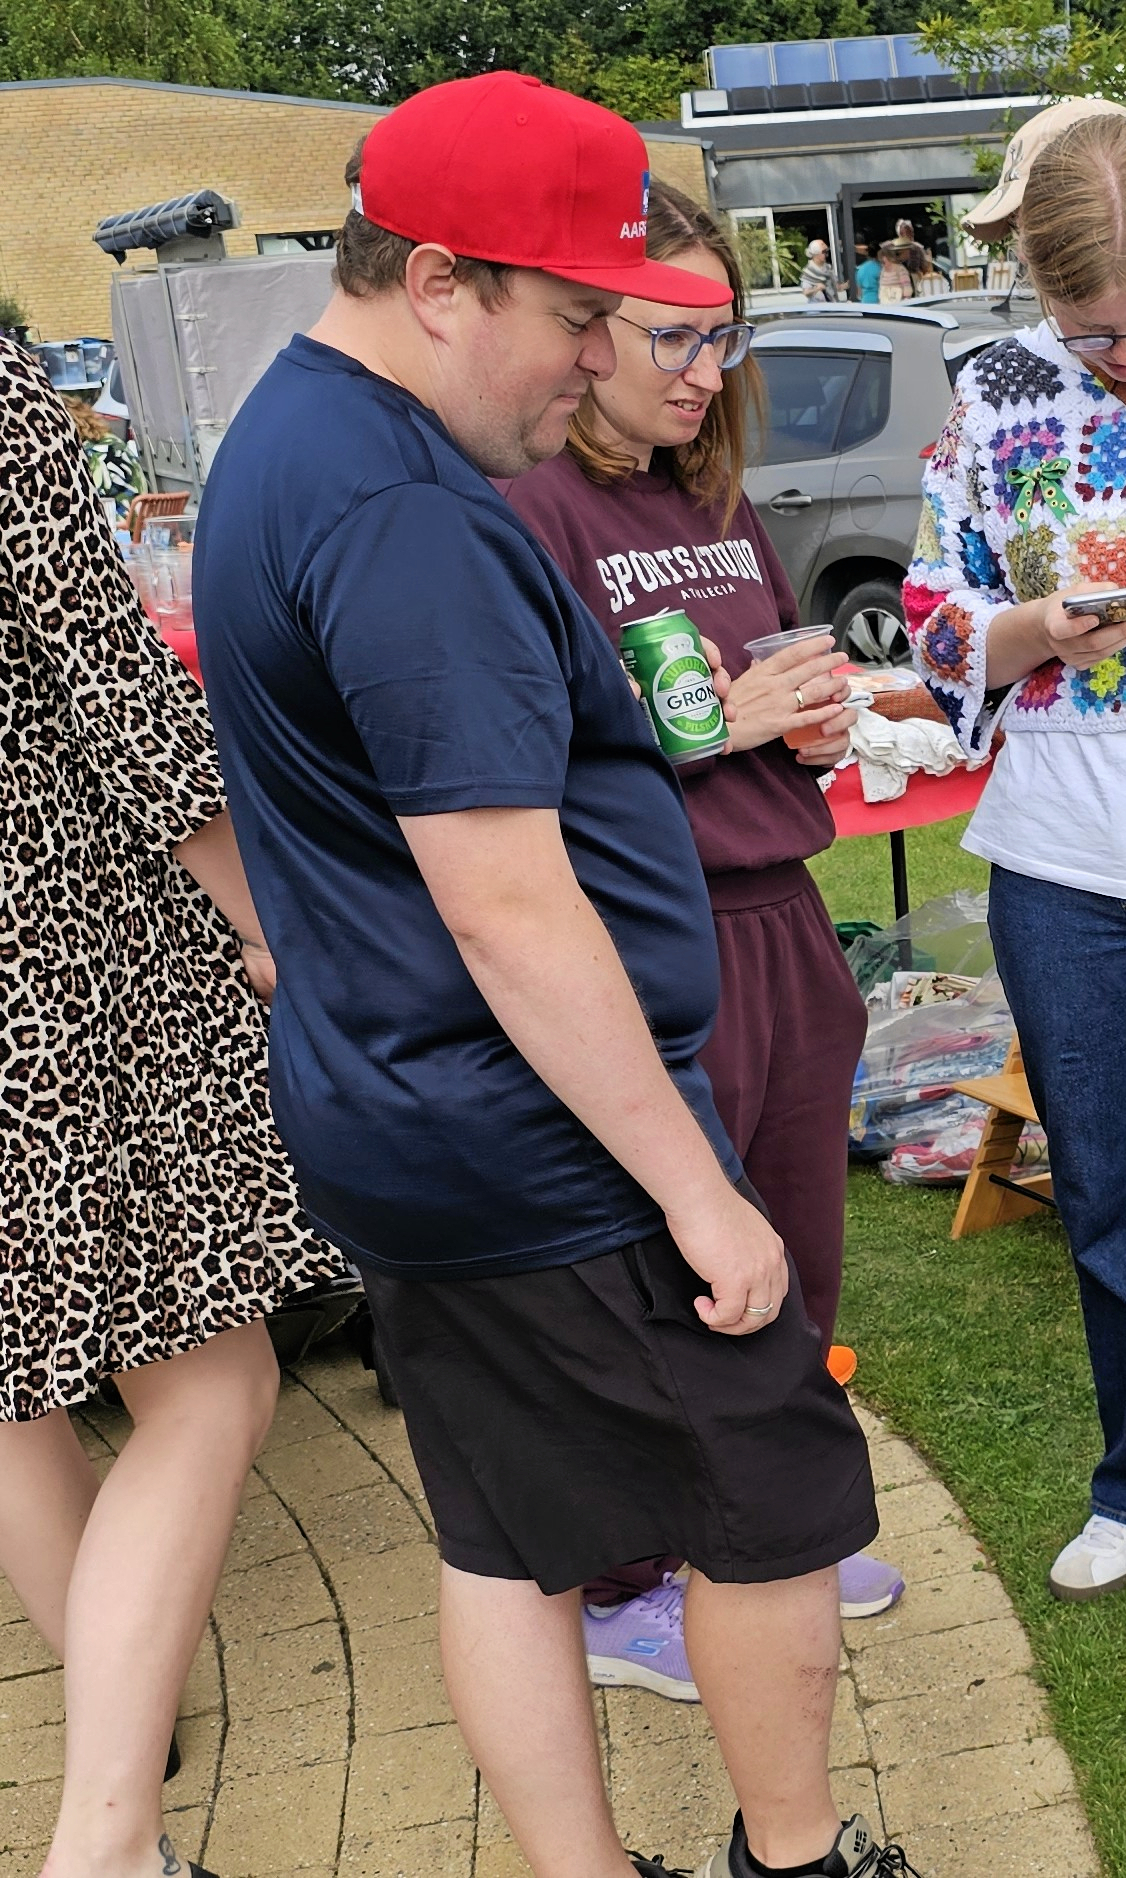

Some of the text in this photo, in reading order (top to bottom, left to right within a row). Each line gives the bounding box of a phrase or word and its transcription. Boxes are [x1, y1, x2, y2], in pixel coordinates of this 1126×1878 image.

[595, 538, 763, 613] SPORTS STUDIO
[680, 582, 737, 601] ATHLECIA
[666, 683, 717, 710] GRØN
